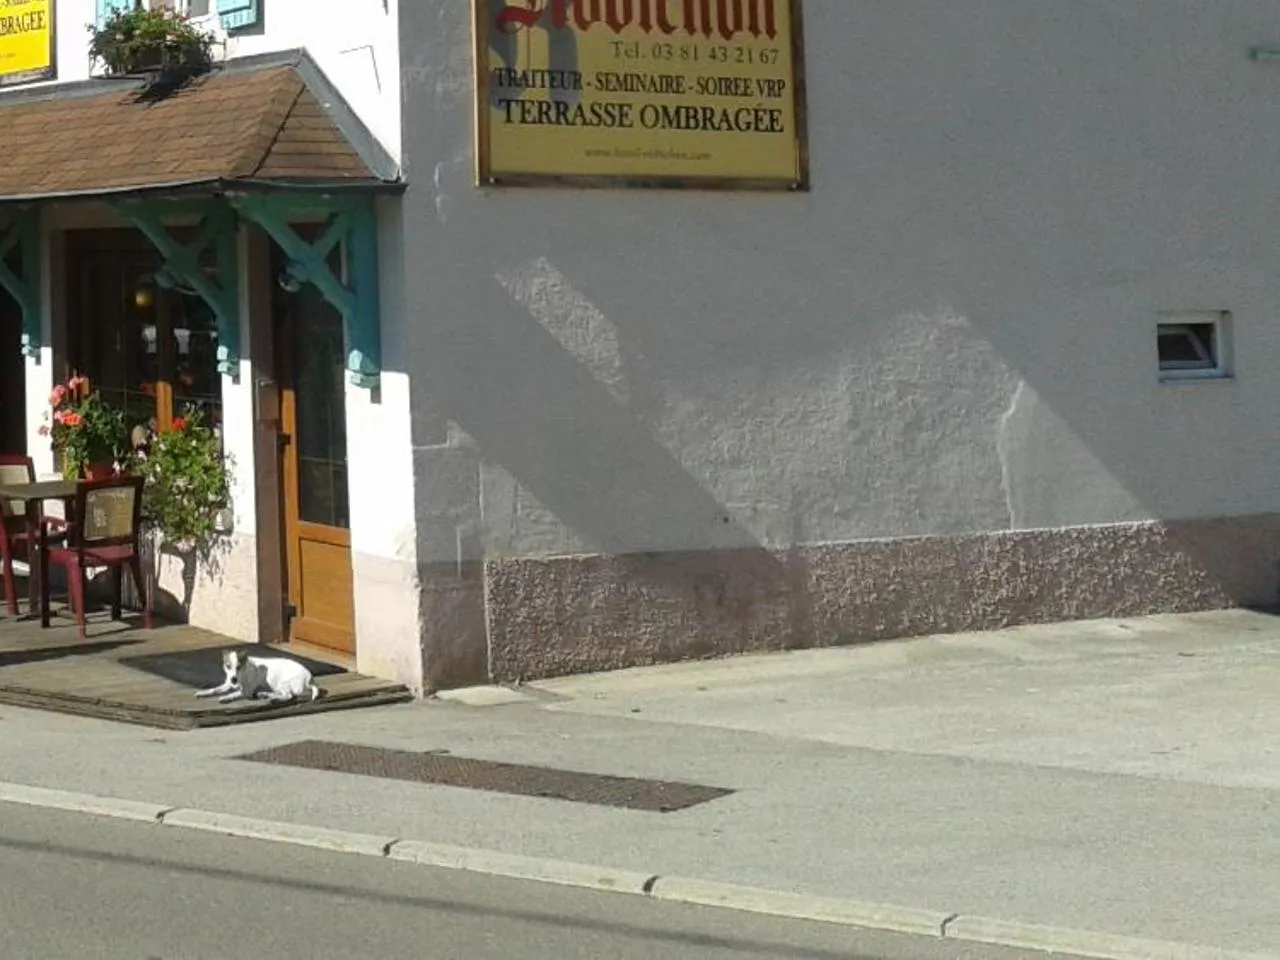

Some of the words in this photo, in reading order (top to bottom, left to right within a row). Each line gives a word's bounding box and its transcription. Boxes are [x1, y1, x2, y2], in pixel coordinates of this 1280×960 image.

[651, 41, 673, 61] 03
[679, 43, 699, 62] 81
[708, 45, 729, 64] 43
[734, 46, 754, 65] 21
[758, 47, 780, 66] 67
[494, 67, 583, 91] TRAITEUR
[757, 78, 786, 99] VRP
[498, 98, 634, 129] TERRASSE
[640, 102, 785, 133] OMBRAGÉE
